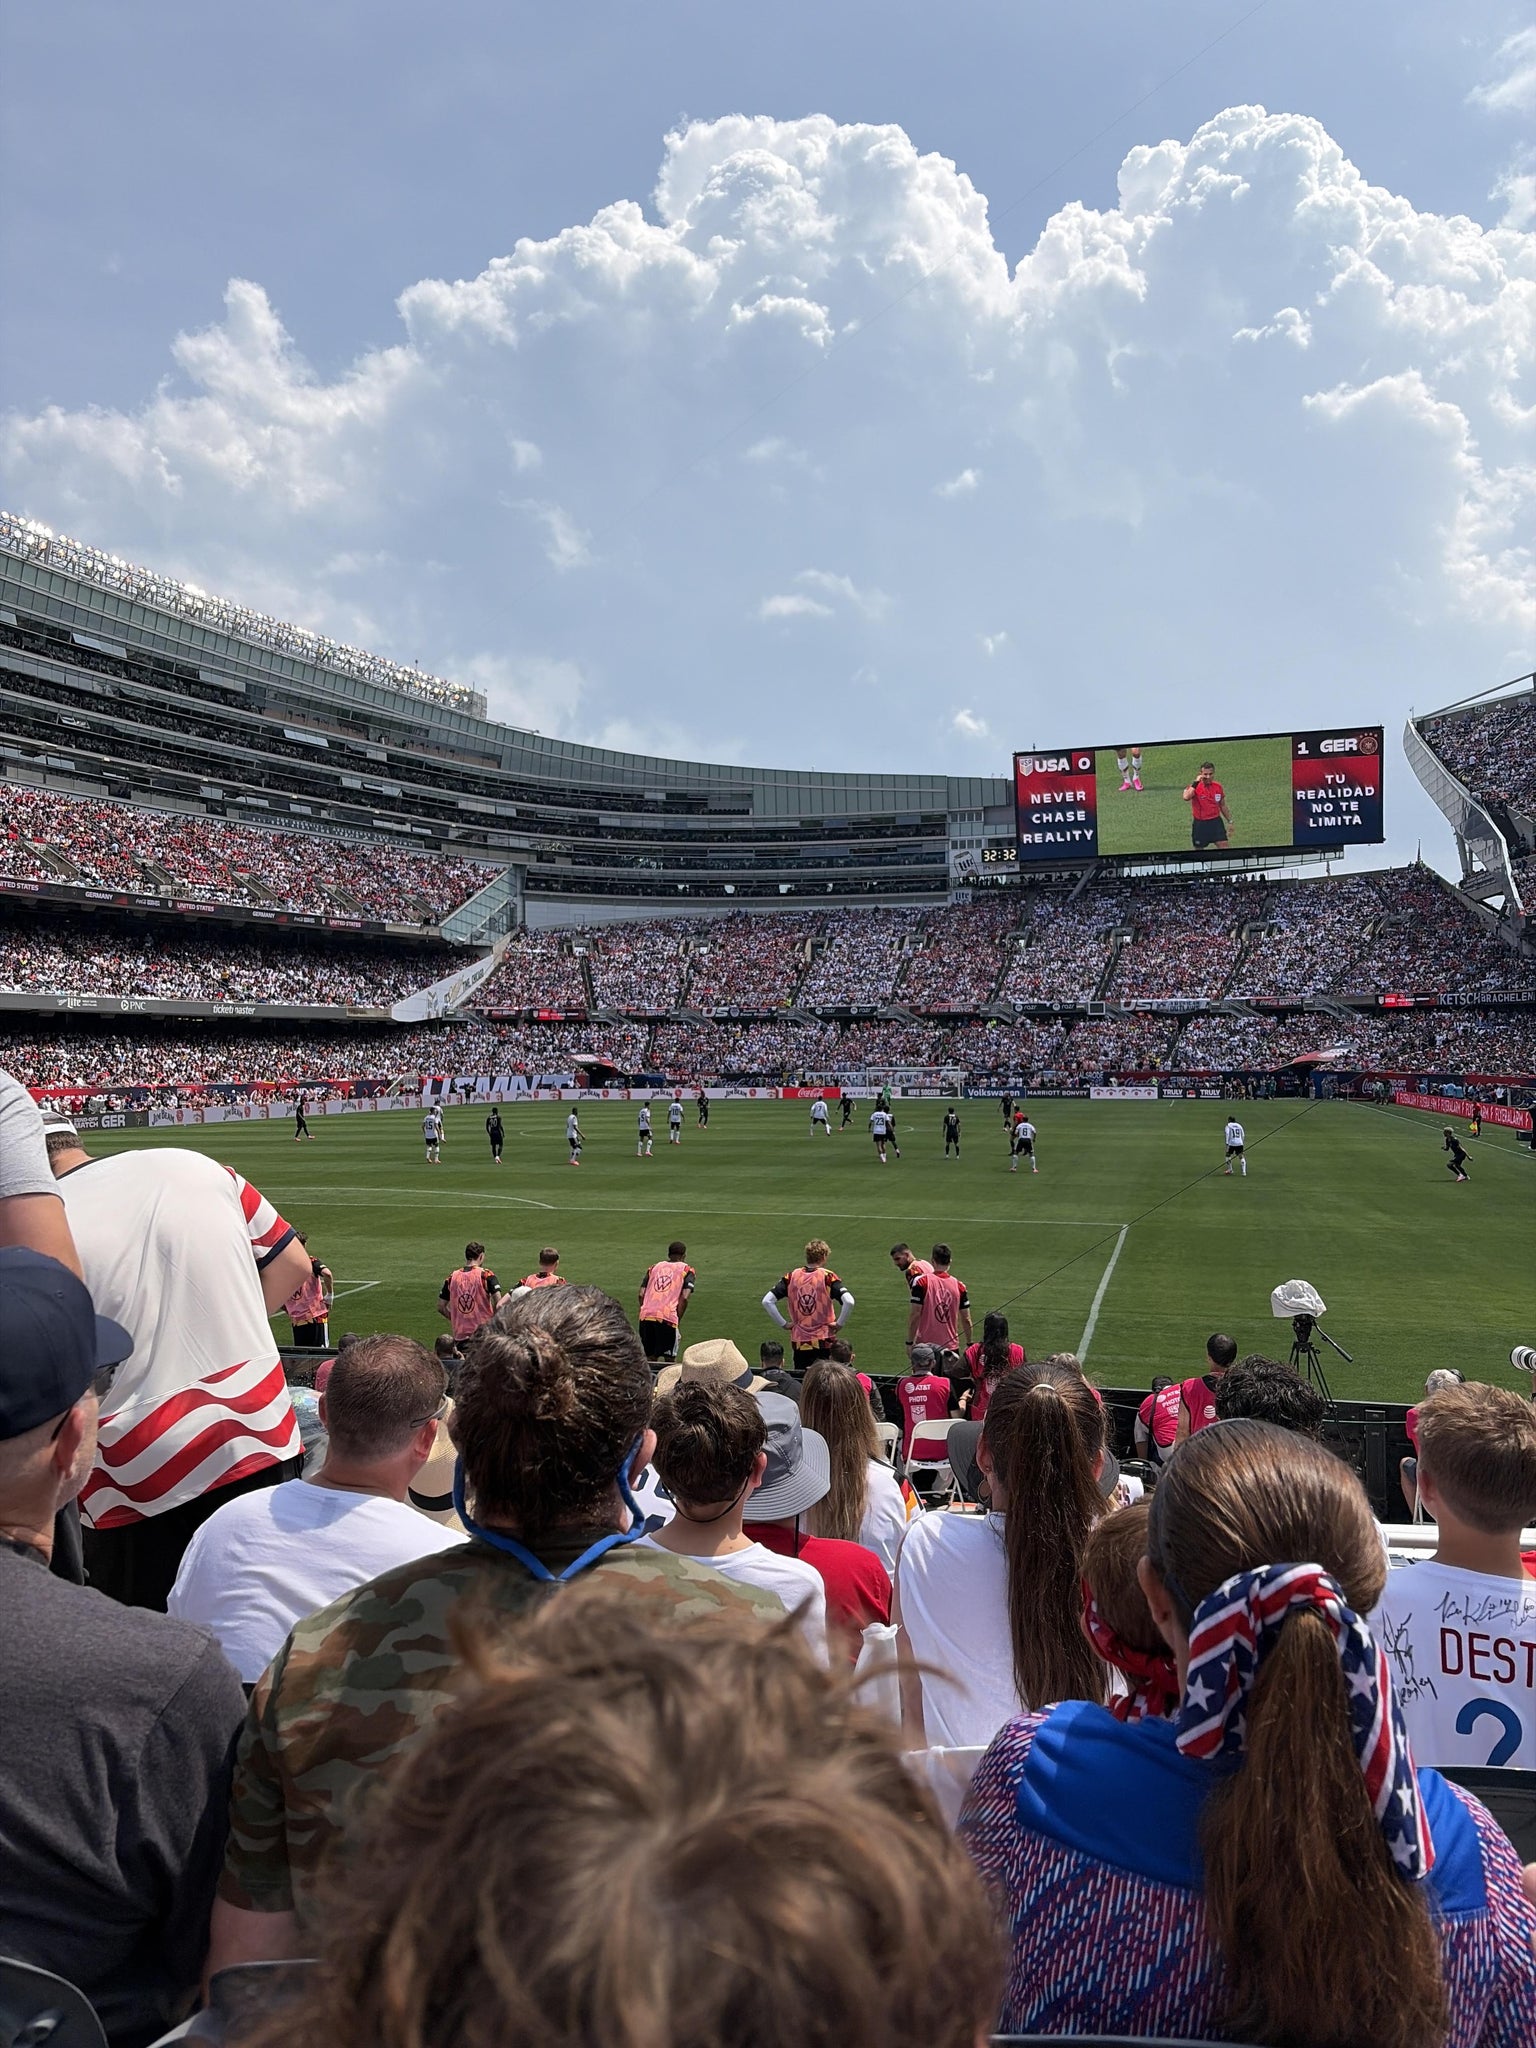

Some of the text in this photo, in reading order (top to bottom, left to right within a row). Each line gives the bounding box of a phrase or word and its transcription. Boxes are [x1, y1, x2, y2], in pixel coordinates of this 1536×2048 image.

[1298, 738, 1358, 754] 1 GER
[1034, 758, 1070, 772] USA
[1324, 774, 1345, 784] TU
[1030, 790, 1086, 804] NEVER
[1296, 786, 1374, 800] REALIDAD
[1312, 801, 1358, 813] NO TE
[1032, 810, 1086, 824] CHASE
[1310, 815, 1362, 827] LIMITA
[1023, 829, 1094, 844] REALITY
[16, 882, 38, 892] STATES
[84, 891, 113, 900] GERMANY
[176, 902, 214, 912] UNITED STATES
[252, 911, 276, 919] GERMANY
[130, 1002, 146, 1010] PNC
[578, 1088, 600, 1098] JIM BEAM
[650, 1088, 672, 1098] JIM BEAM
[724, 1088, 747, 1098] JIM BEAM
[798, 1088, 824, 1098] Coca-Cola
[152, 1108, 174, 1126] JIM BEAM
[671, 1108, 678, 1116] 10
[102, 1114, 126, 1128] GER
[875, 1117, 884, 1126] 23
[1232, 1128, 1240, 1138] 19
[908, 1395, 928, 1403] PHOTO
[1440, 1627, 1536, 1688] DEST
